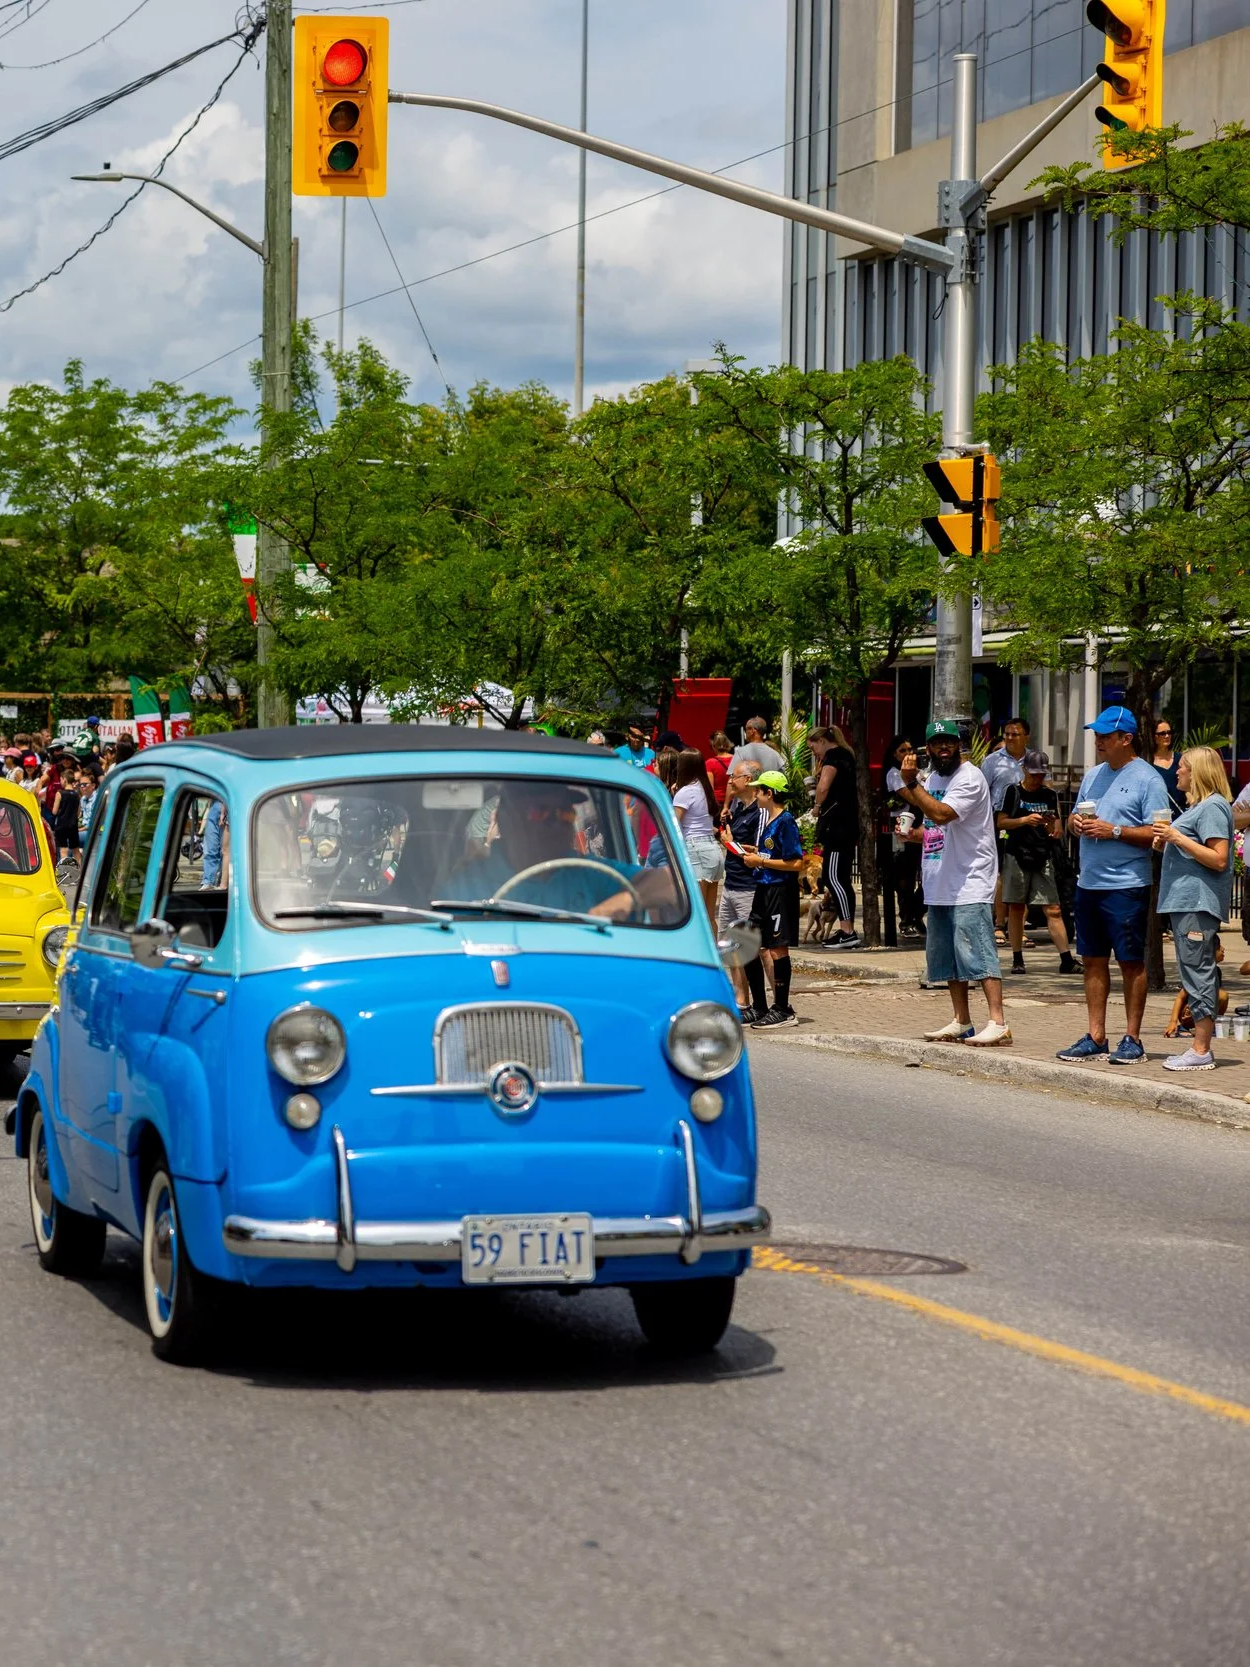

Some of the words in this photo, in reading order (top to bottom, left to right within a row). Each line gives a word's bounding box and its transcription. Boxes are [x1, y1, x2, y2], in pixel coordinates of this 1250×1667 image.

[934, 722, 945, 733] LA
[771, 914, 782, 932] 7
[471, 1232, 503, 1268] 59
[519, 1230, 585, 1266] FIAT
